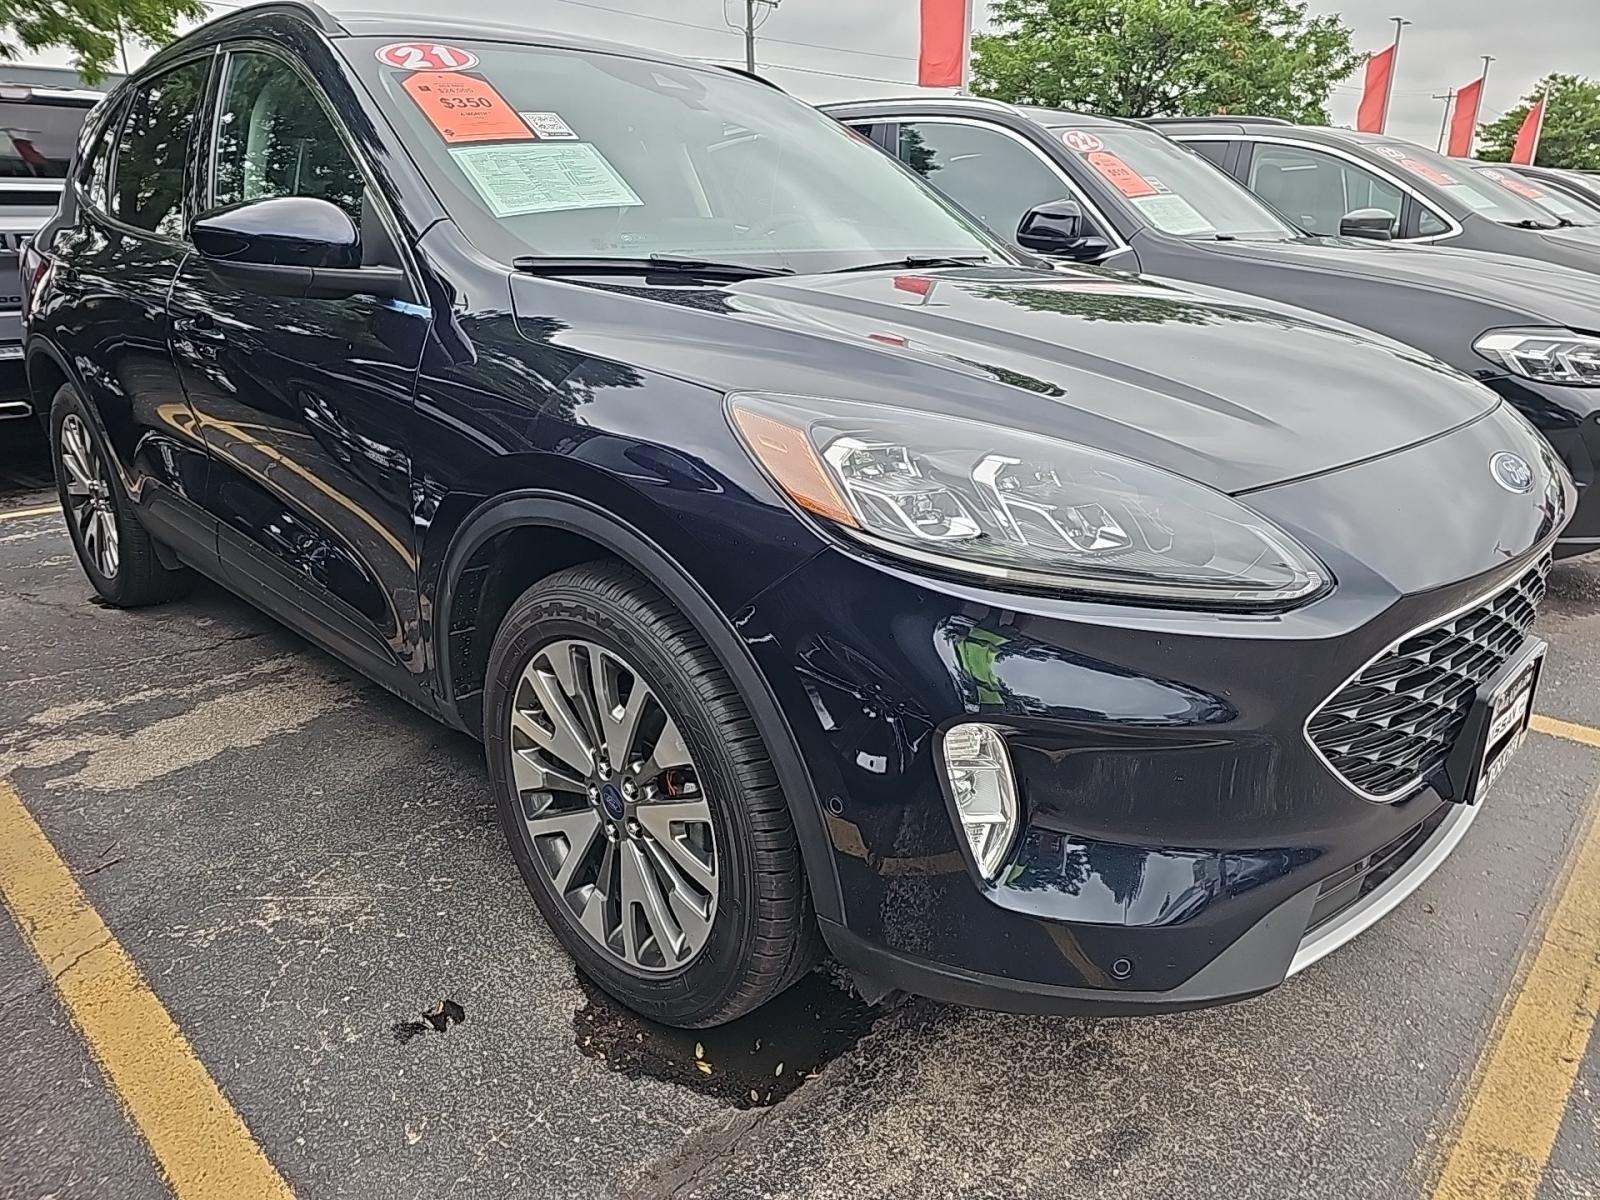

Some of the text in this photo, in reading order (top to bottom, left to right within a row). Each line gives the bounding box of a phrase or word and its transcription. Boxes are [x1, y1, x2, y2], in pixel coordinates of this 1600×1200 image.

[393, 45, 459, 69] 21
[439, 97, 492, 109] $350
[1502, 459, 1530, 484] Ford
